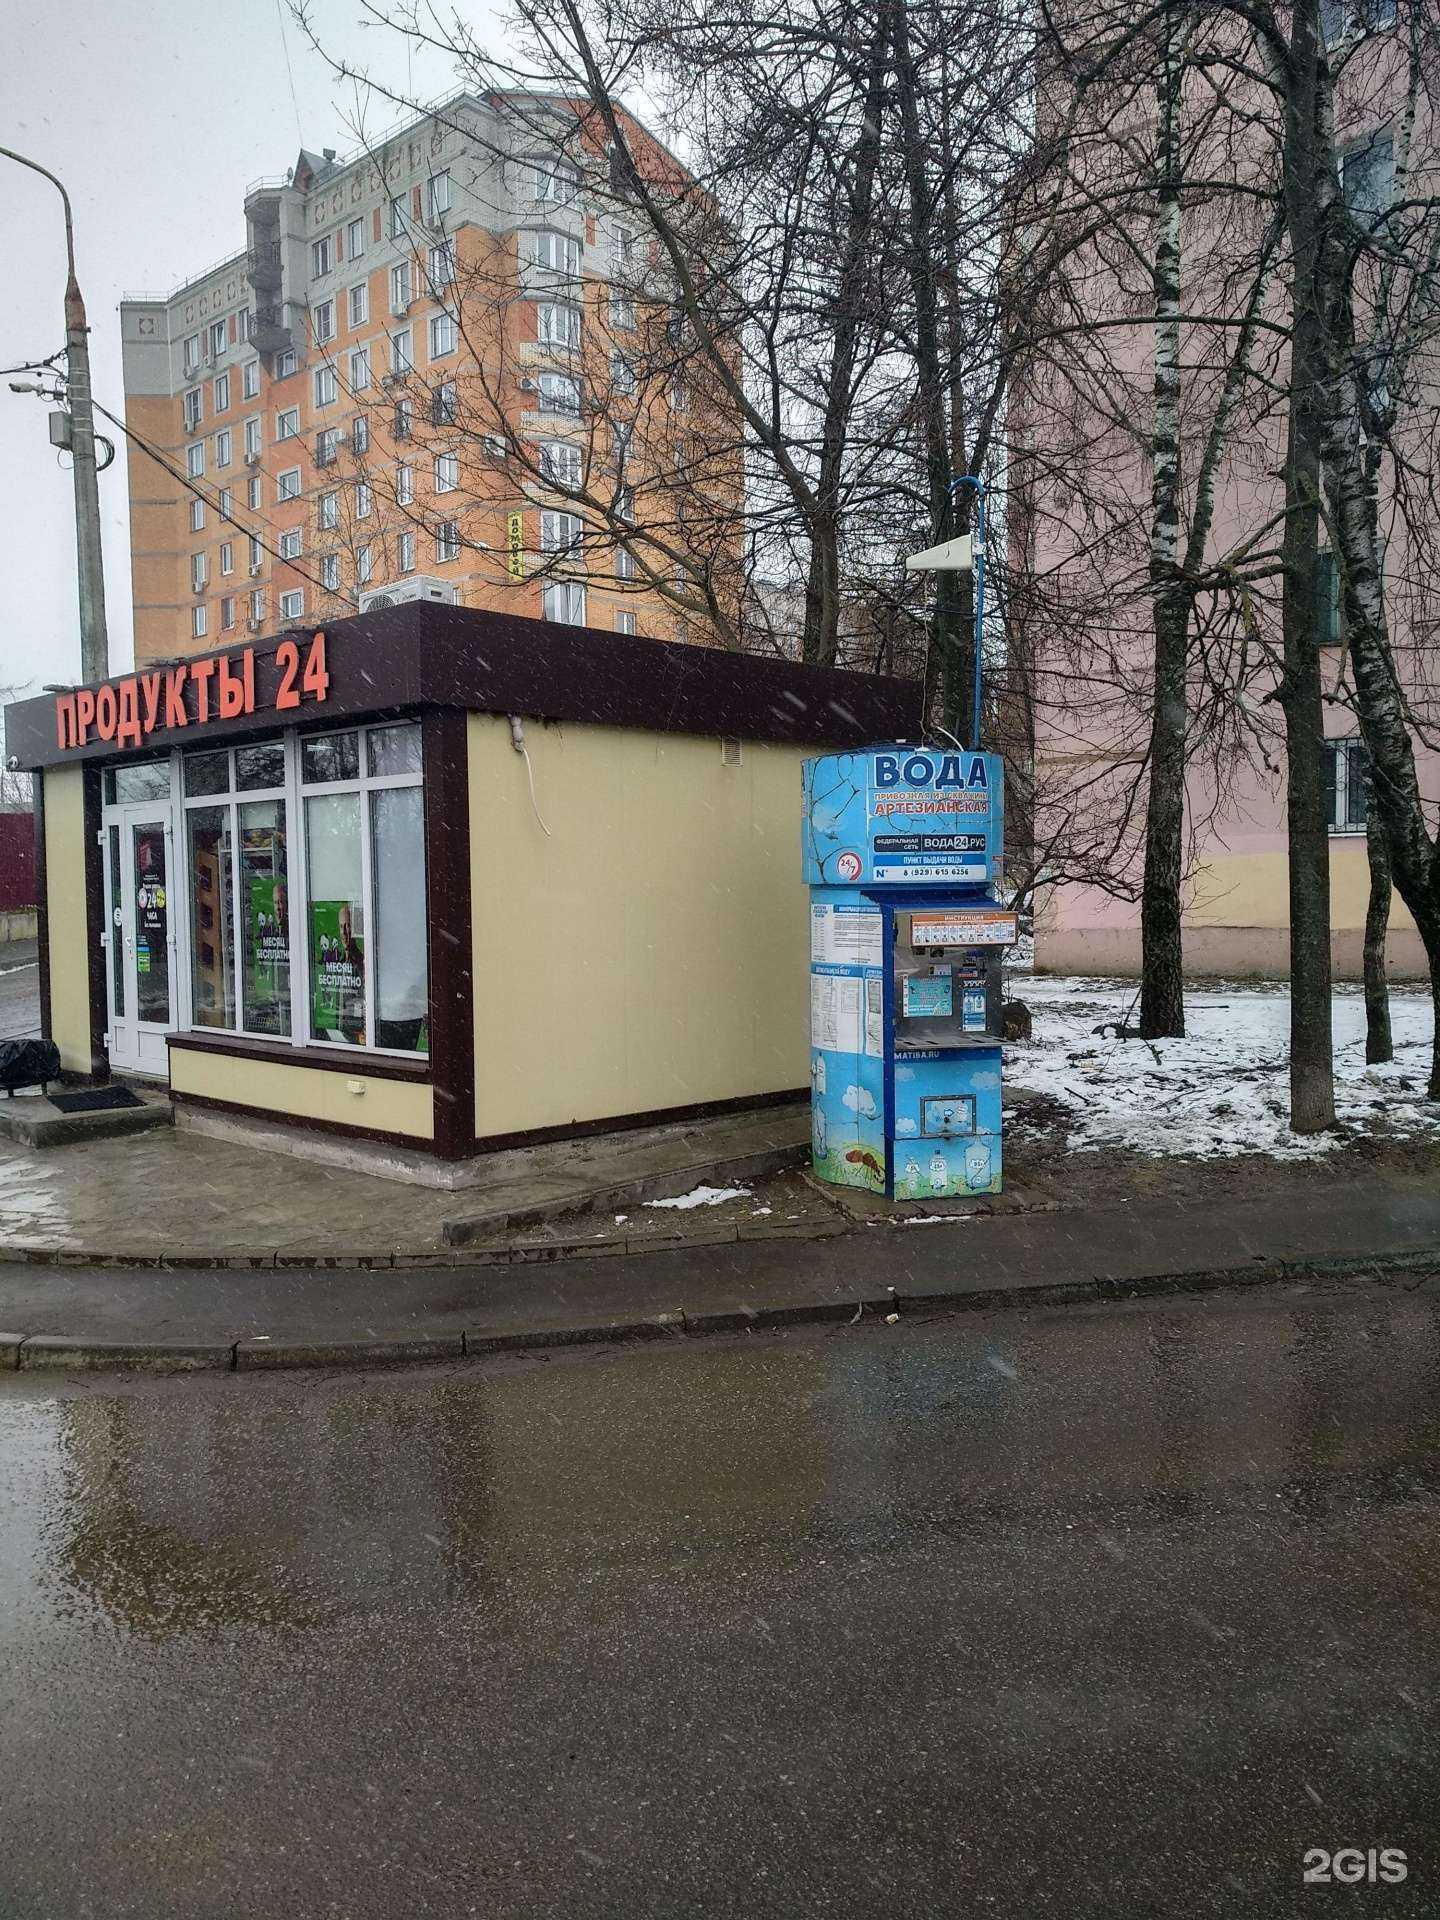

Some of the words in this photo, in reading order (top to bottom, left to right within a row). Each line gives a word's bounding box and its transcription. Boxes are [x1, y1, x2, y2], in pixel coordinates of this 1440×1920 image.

[57, 648, 255, 749] ПРОДУКТЫ
[276, 632, 329, 710] 24
[875, 755, 988, 790] ВОДА
[875, 802, 988, 815] АРТЕЗИАНСКАЯ
[903, 856, 922, 864] ПУНКТ
[263, 937, 285, 949] МЕСЯЦ
[256, 948, 289, 959] БЕСПЛАТН
[326, 962, 352, 975] МЕСЯЦ
[318, 974, 362, 987] БЕСПЛАТНО
